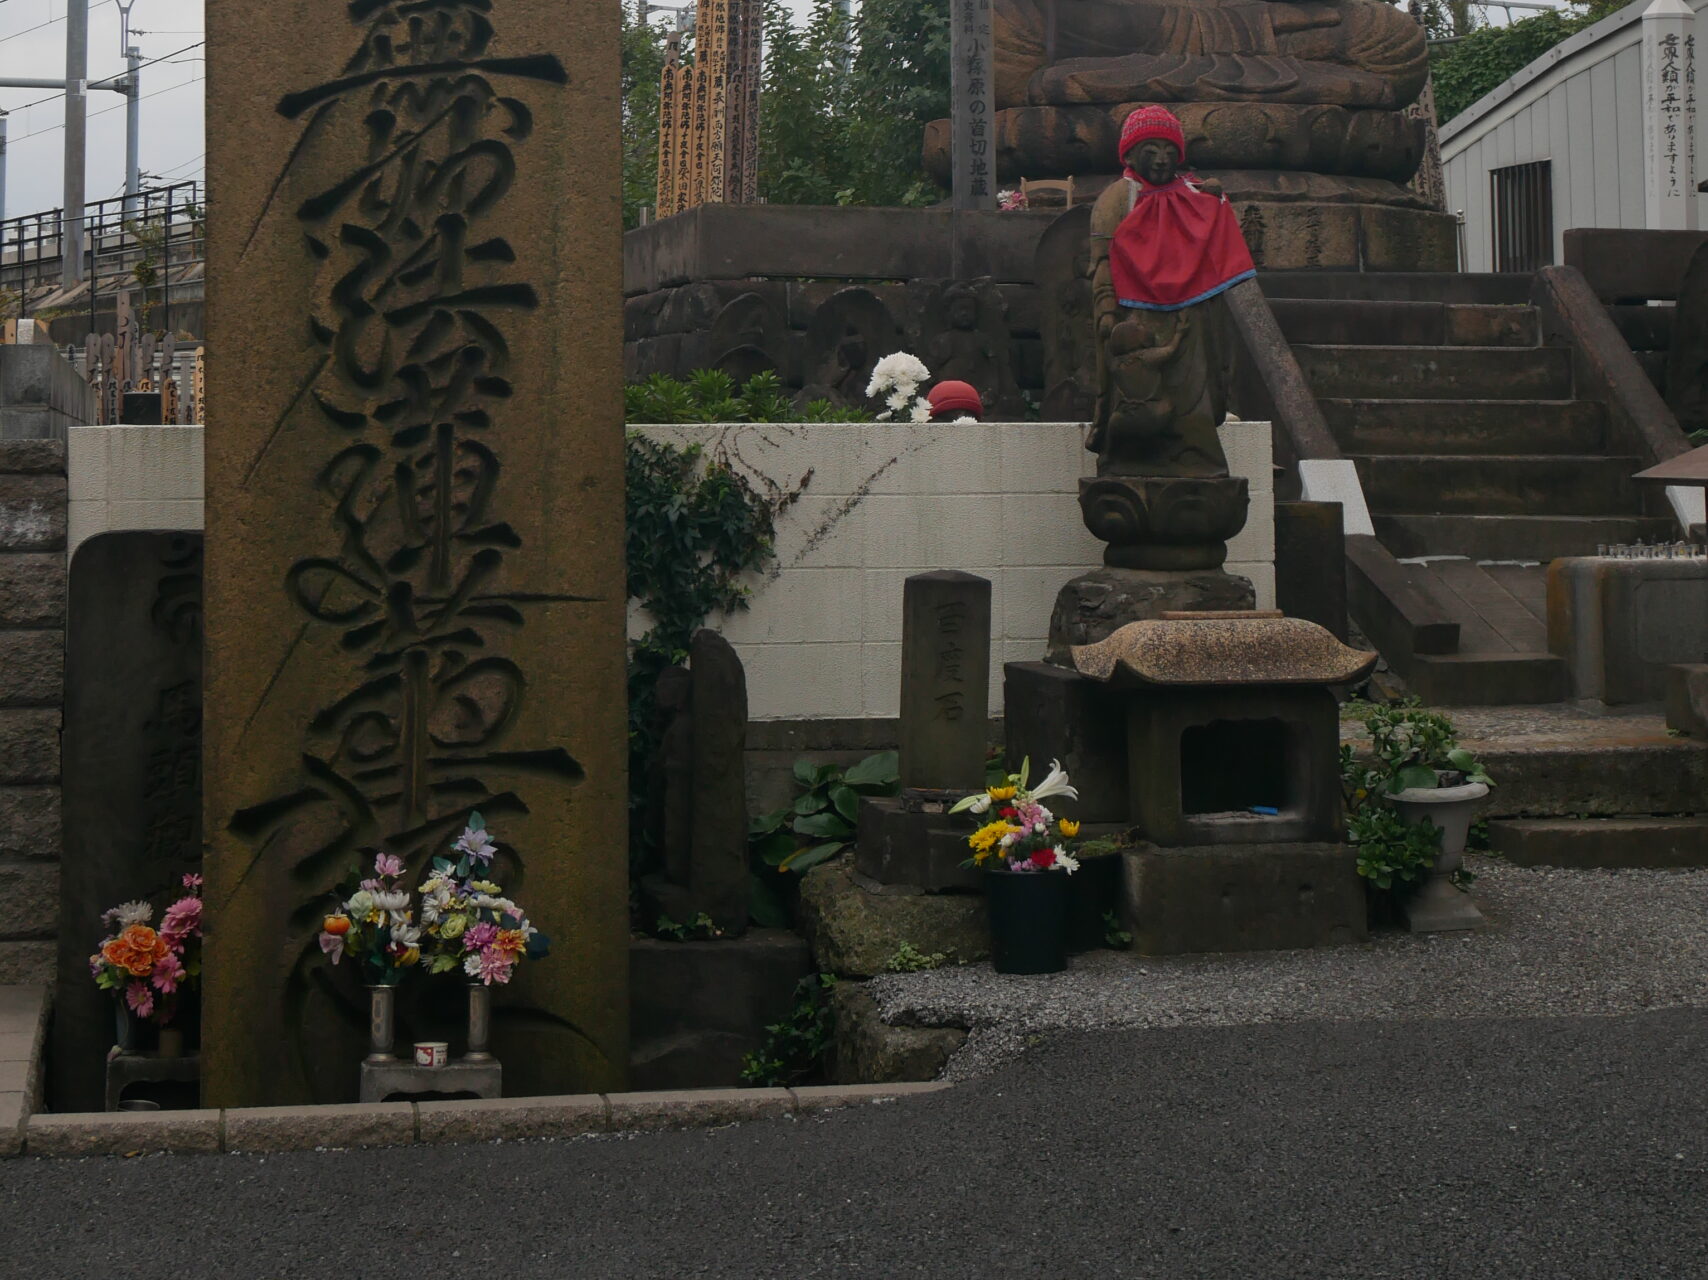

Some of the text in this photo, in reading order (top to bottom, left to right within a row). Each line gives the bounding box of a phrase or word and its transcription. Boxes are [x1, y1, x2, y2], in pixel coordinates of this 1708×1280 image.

[1658, 33, 1681, 198] 世界人類が平和でありますように
[933, 600, 966, 722] 百度石
